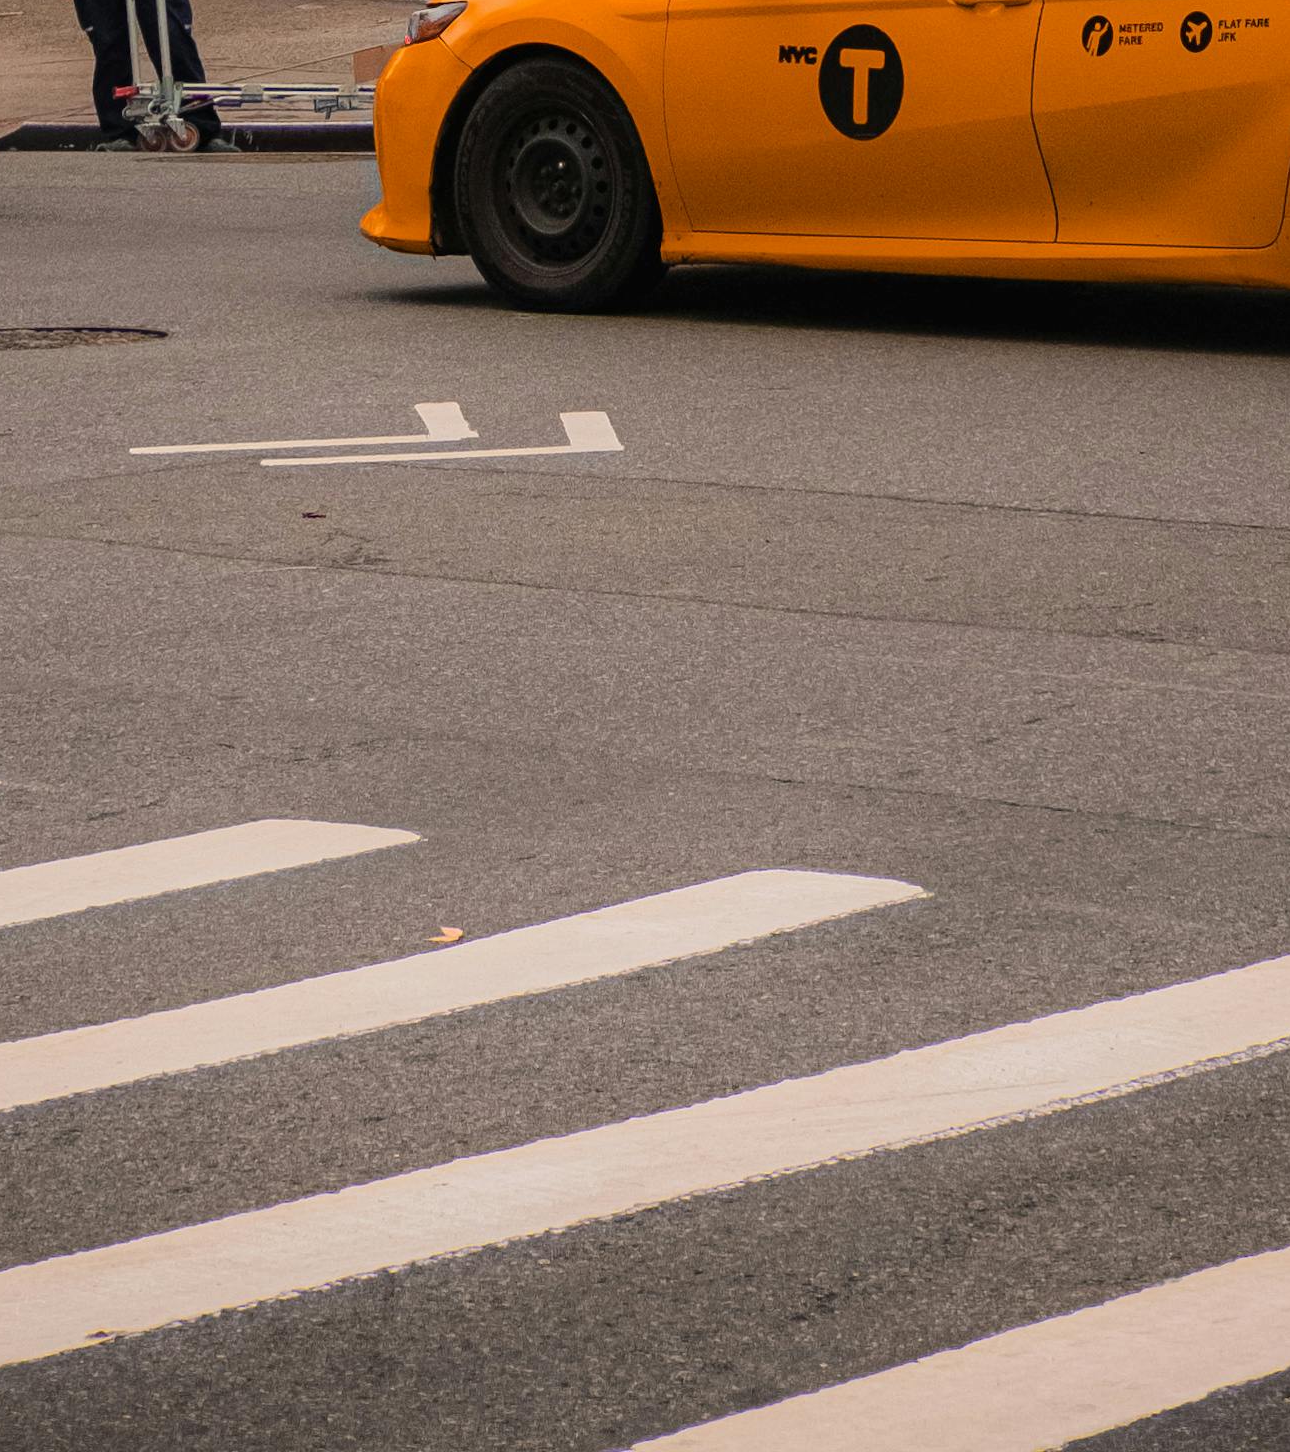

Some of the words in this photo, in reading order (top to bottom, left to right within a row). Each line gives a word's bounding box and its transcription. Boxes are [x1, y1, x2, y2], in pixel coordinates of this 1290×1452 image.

[1119, 22, 1164, 34] METERED
[1218, 19, 1242, 29] FLAT
[1245, 18, 1270, 28] FARE
[1119, 36, 1143, 45] FARE
[1218, 33, 1237, 42] JFK
[778, 45, 818, 65] NYC
[839, 48, 886, 124] T
